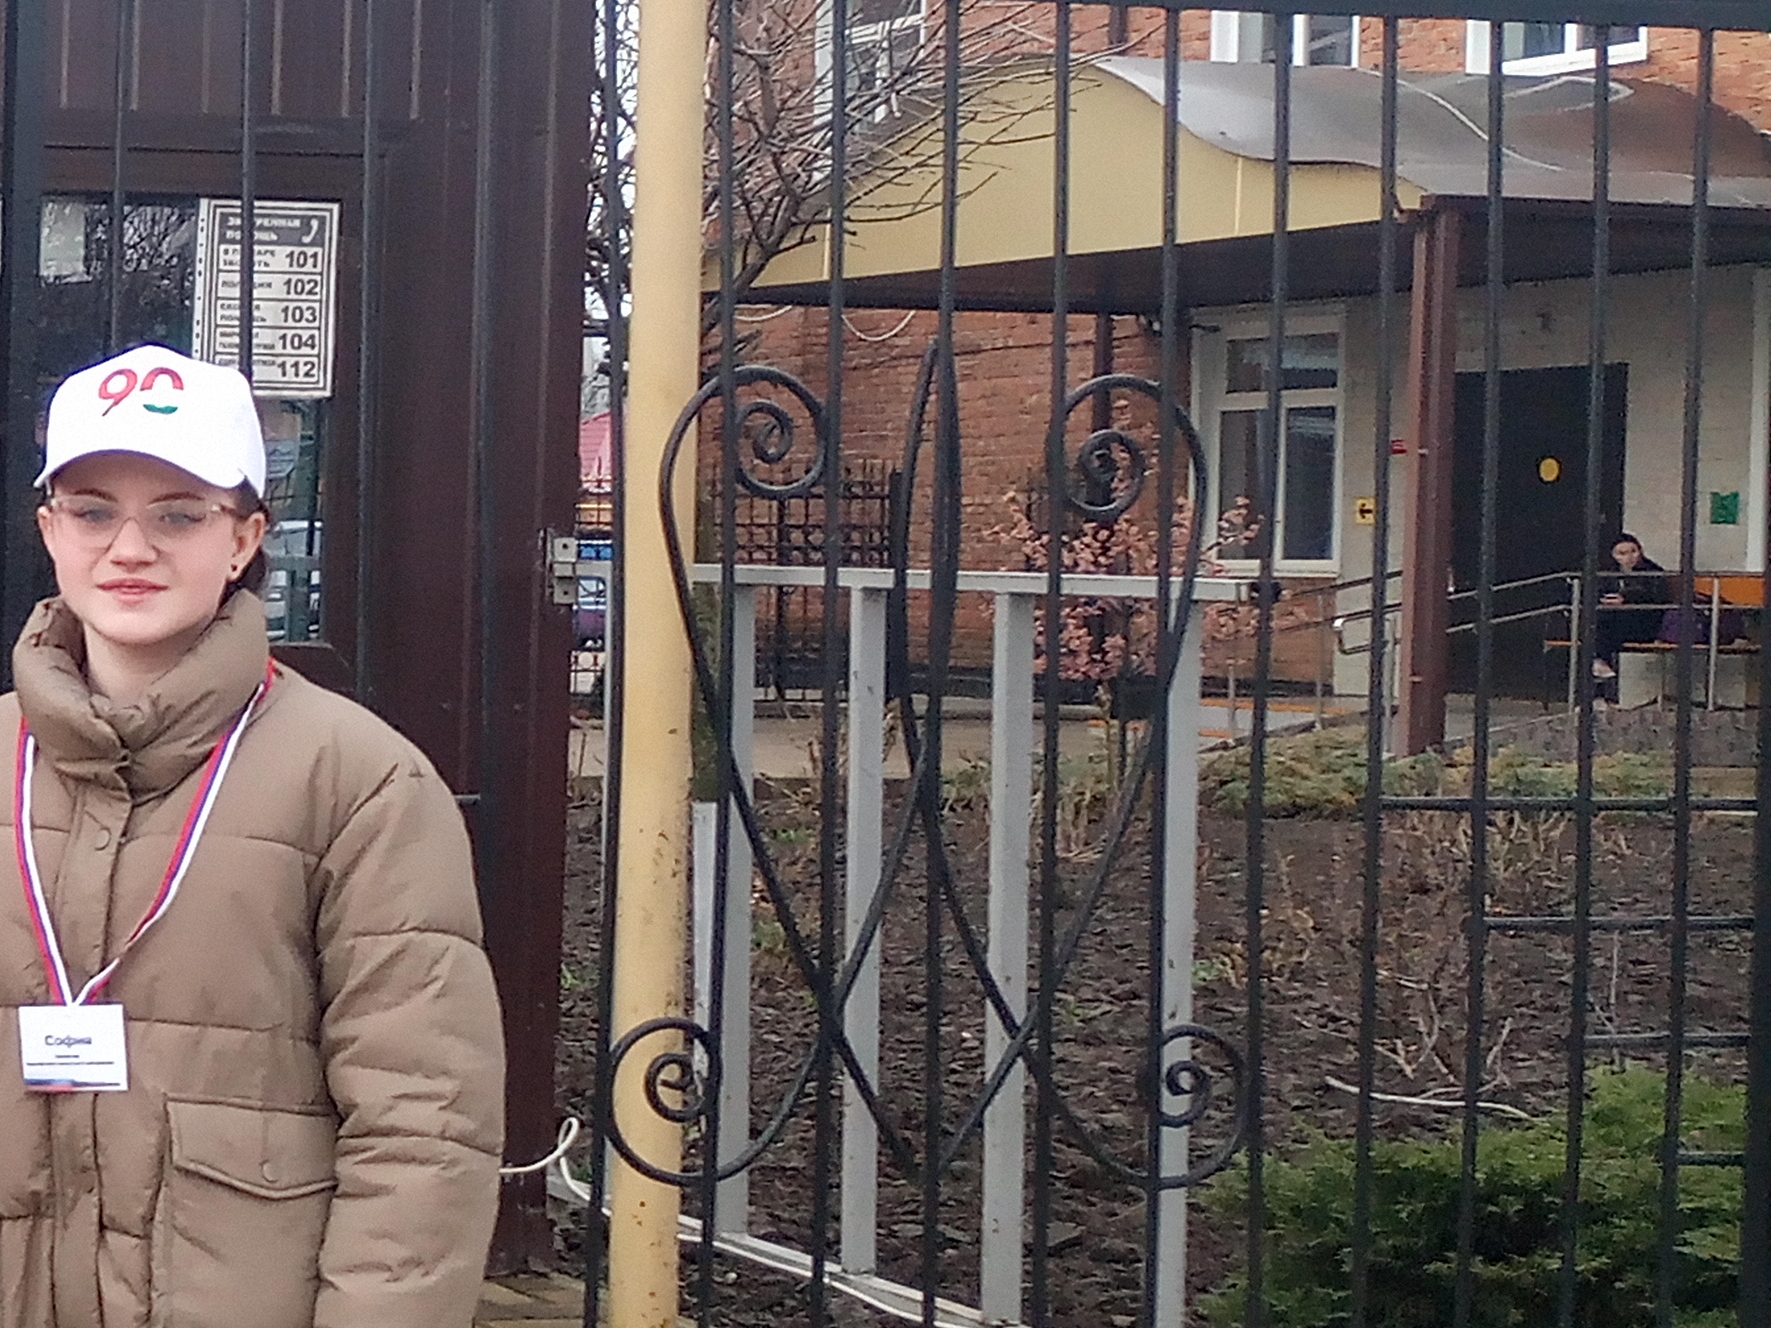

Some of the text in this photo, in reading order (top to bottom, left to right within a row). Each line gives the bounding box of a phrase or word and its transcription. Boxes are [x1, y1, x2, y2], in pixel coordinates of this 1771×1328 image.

[285, 250, 319, 269] 101
[283, 278, 319, 296] 102
[281, 305, 317, 323] 103
[279, 333, 316, 351] 104
[277, 360, 316, 378] 112
